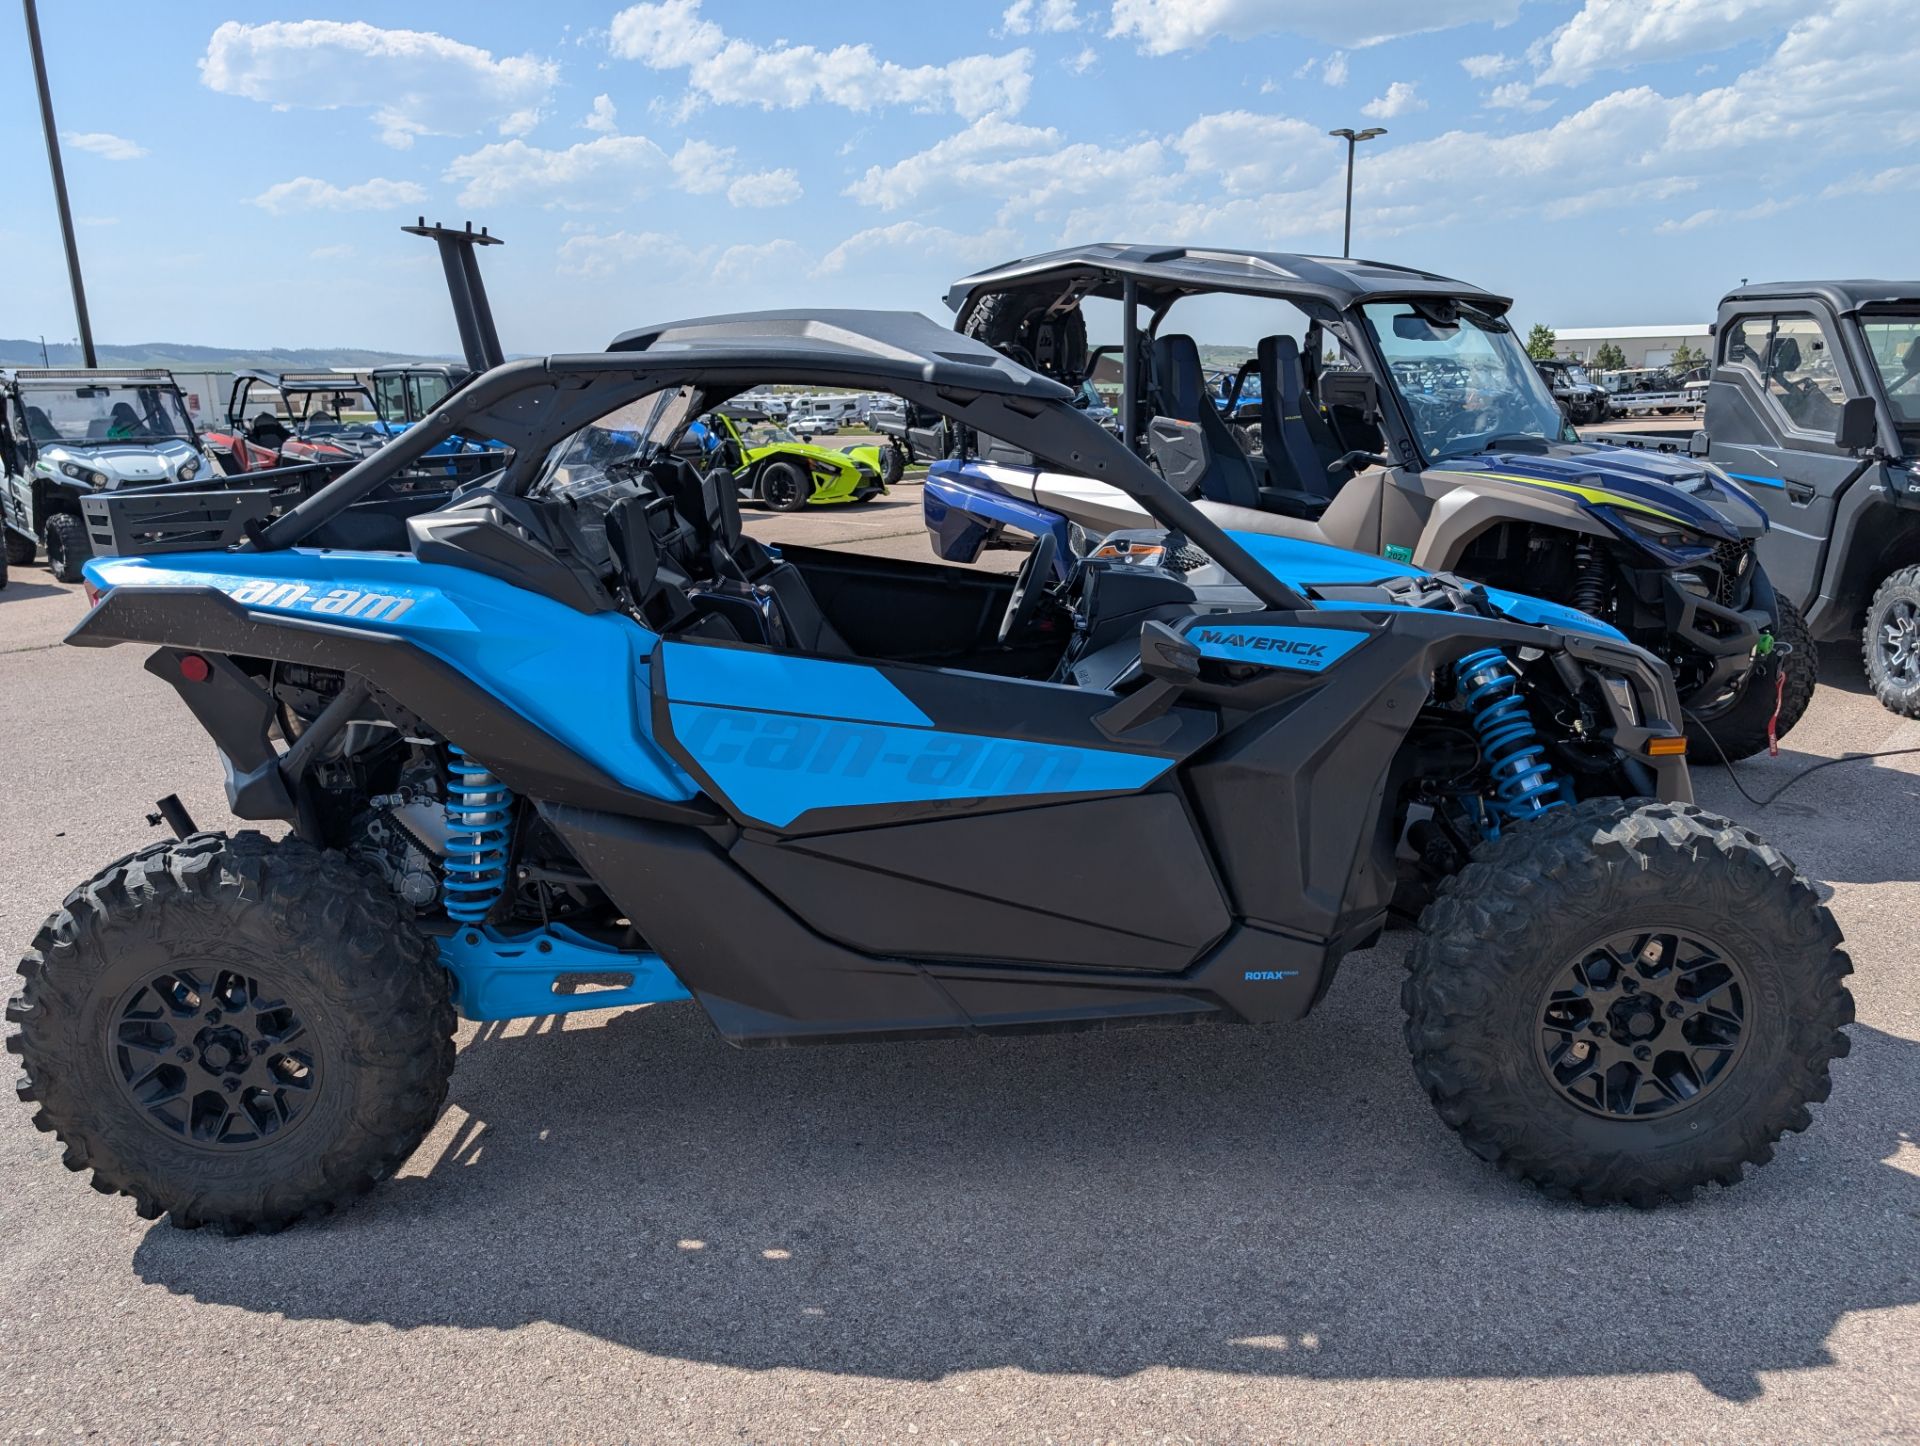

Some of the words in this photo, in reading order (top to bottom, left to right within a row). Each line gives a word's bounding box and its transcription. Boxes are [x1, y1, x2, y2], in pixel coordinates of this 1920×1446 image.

[224, 579, 416, 622] an-am
[1198, 629, 1329, 658] MAVERICK
[1297, 658, 1321, 667] DS
[684, 709, 1085, 792] can-am
[1244, 970, 1283, 981] ROTAX
